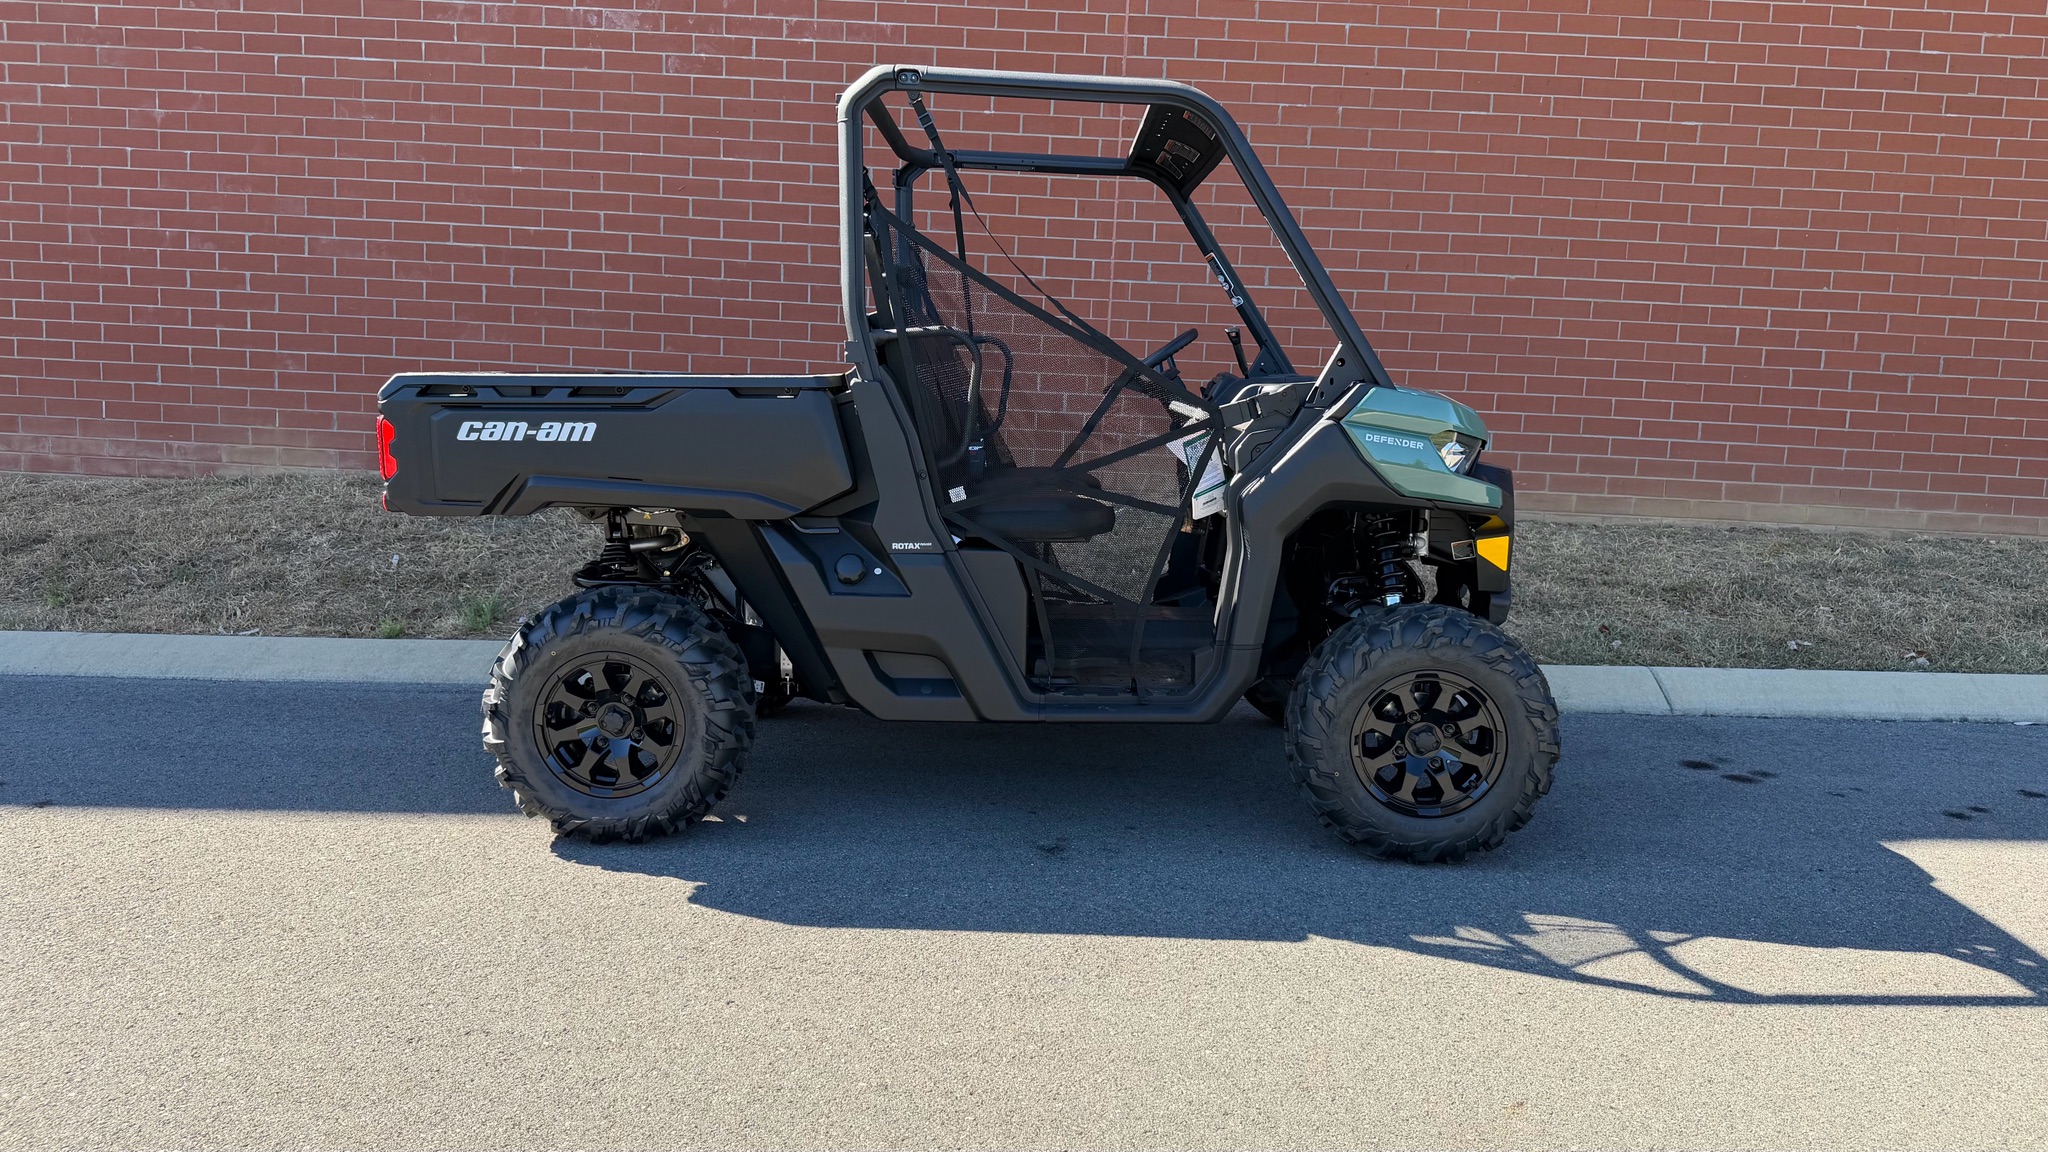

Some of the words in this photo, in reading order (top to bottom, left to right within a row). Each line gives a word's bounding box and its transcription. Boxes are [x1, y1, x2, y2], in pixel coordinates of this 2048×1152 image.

[456, 421, 597, 442] can-am
[1365, 433, 1424, 450] DEFENDER
[891, 542, 920, 550] ROTAX
